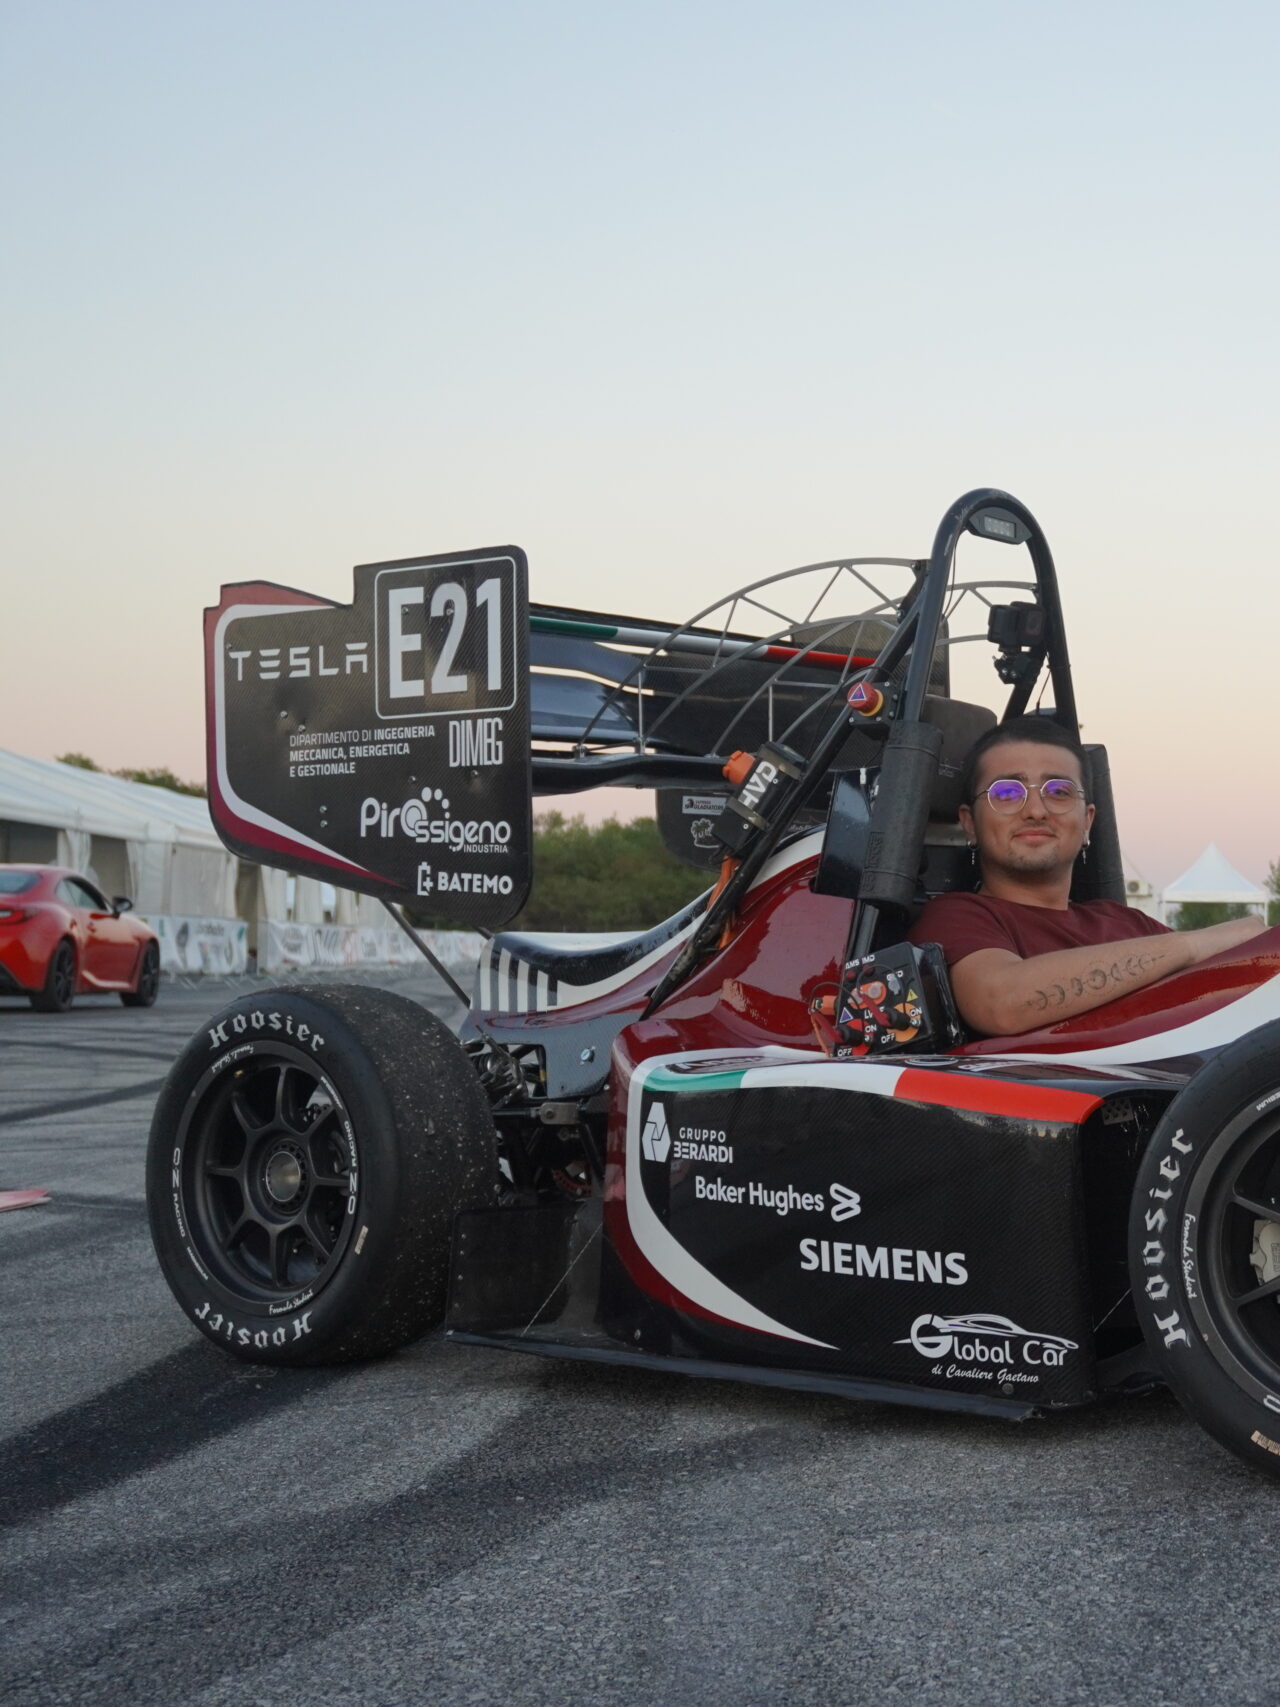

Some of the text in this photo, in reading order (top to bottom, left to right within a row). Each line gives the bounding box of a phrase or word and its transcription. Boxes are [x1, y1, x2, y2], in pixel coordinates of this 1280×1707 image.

[389, 578, 501, 699] E21
[228, 642, 368, 681] TESLA
[290, 725, 435, 747] DIPARTIMENTO DI INGEGNERIA
[290, 742, 410, 763] MECCANICA, ENERGETICA
[449, 717, 503, 767] DIMEG
[290, 762, 356, 777] E GESTIONALE
[463, 844, 508, 853] INDUSTRIA
[438, 871, 513, 895] BATEMO
[208, 1010, 325, 1051] Hoosier
[673, 1141, 733, 1164] BERARDI
[679, 1127, 726, 1143] GRUPPO
[695, 1176, 824, 1216] Baker Hughes
[1143, 1128, 1193, 1350] Hoosier
[800, 1238, 968, 1286] SIEMENS
[195, 1302, 313, 1348] Hoosier
[911, 1314, 1067, 1366] Global Car
[932, 1364, 1039, 1384] di Cavaliere Gaetano
